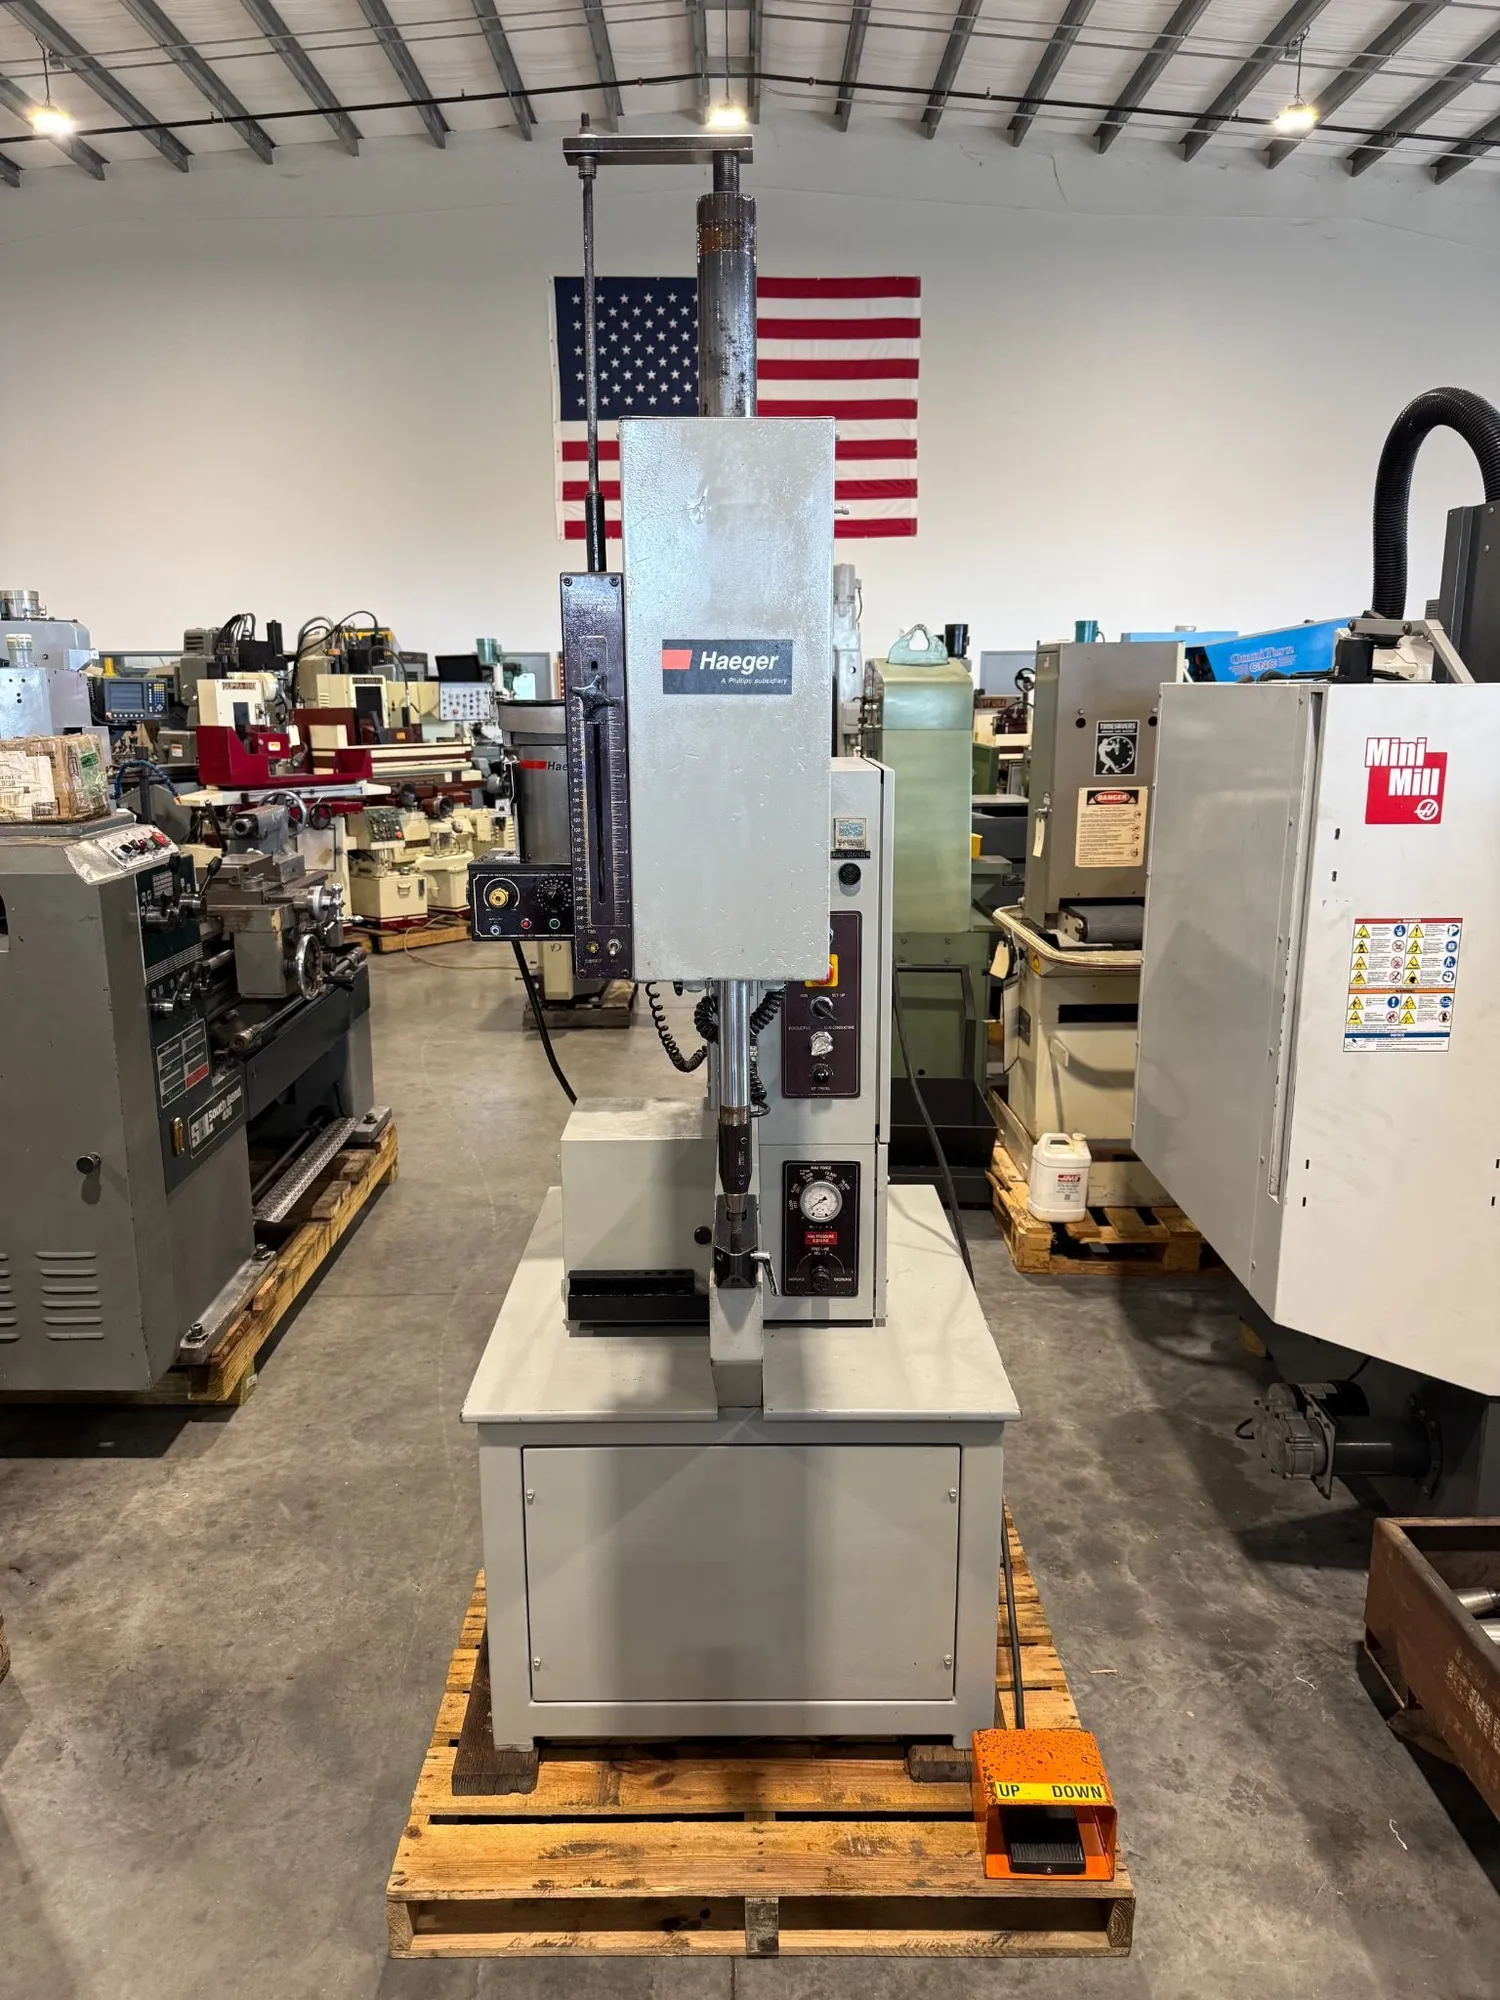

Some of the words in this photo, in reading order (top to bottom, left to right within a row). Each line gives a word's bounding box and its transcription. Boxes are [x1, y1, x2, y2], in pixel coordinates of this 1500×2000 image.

[699, 651, 779, 675] Haeger
[1365, 737, 1427, 767] Mini
[1388, 768, 1440, 796] Mill
[208, 1099, 227, 1122] South
[999, 1784, 1020, 1797] UP
[1052, 1785, 1103, 1799] DOWN
